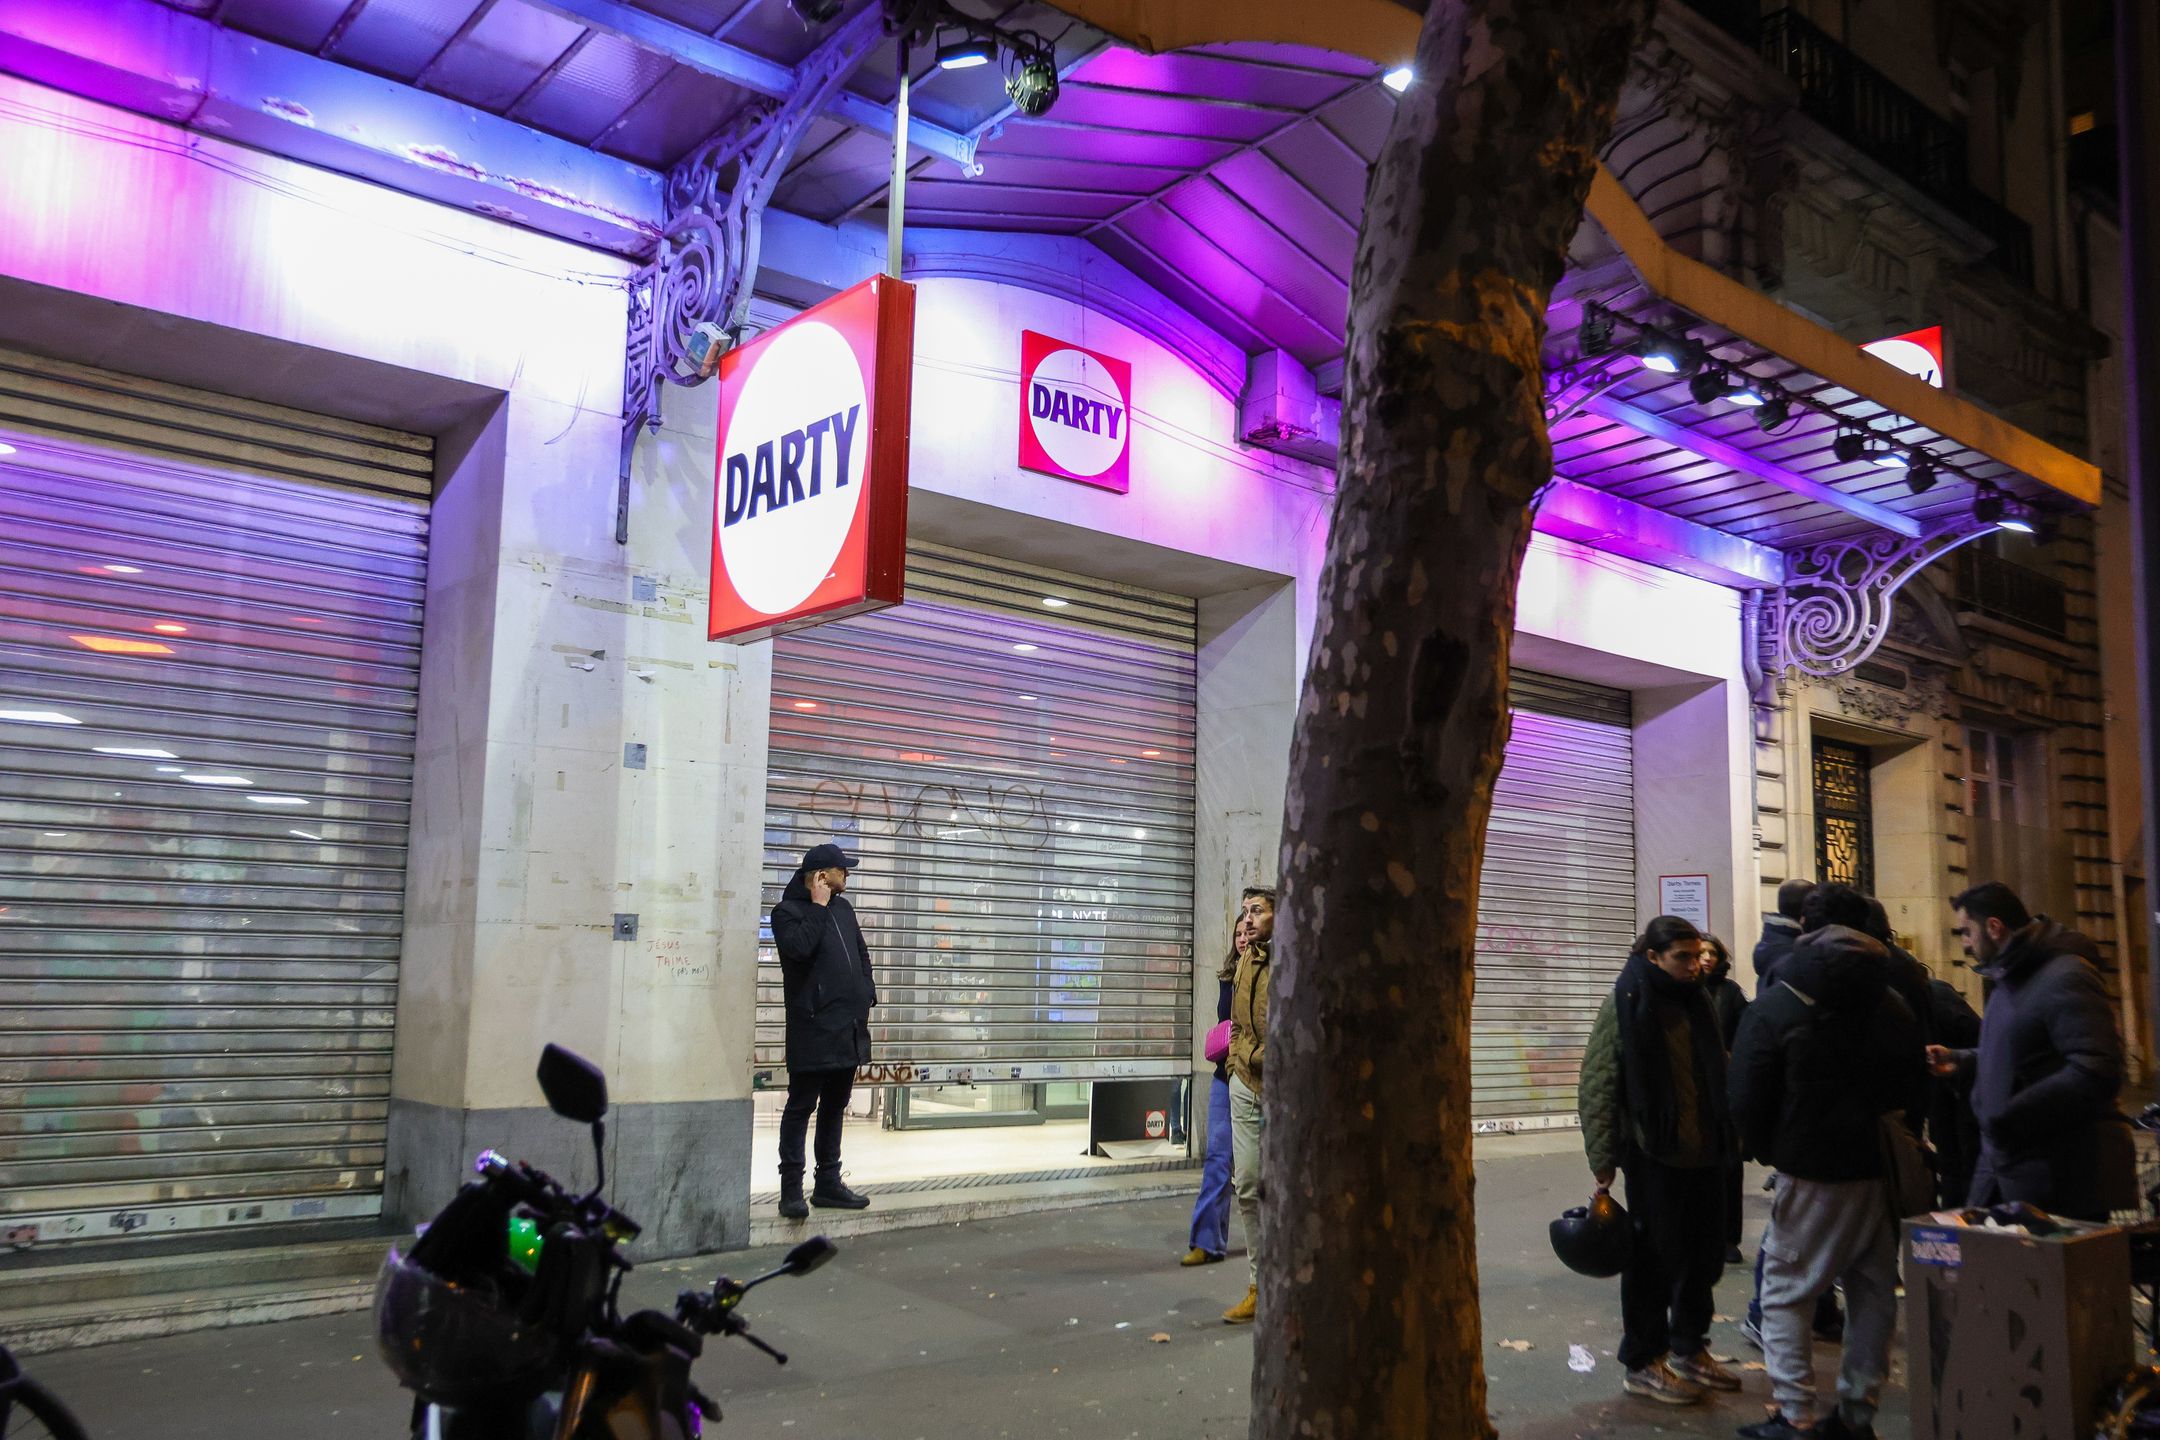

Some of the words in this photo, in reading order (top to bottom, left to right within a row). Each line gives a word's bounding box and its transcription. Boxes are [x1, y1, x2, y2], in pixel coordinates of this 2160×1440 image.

[1032, 383, 1123, 440] DARTY
[724, 403, 861, 528] DARTY
[1147, 1120, 1164, 1128] DARTY
